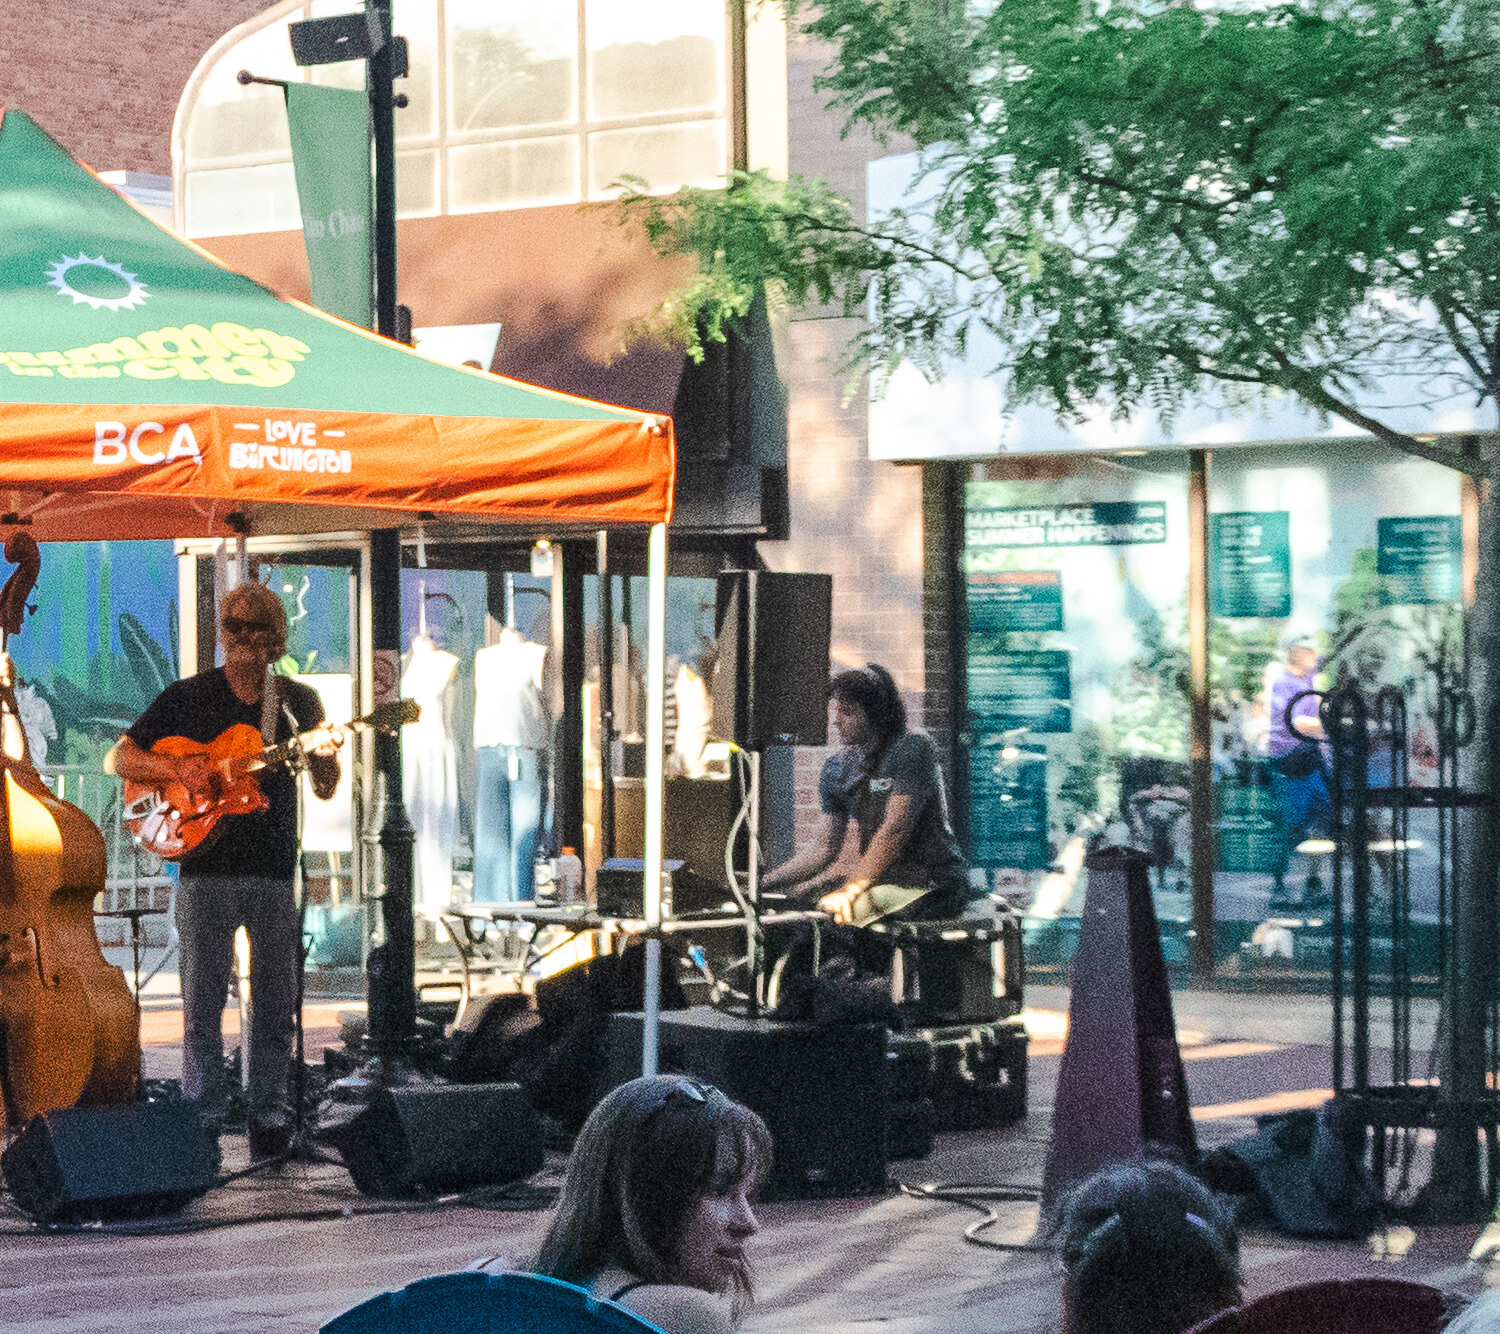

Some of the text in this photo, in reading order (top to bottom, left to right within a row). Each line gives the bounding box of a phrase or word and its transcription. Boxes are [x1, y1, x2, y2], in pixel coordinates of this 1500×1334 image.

[264, 417, 317, 446] LOVE
[92, 420, 352, 473] BCA BURLINGTON
[967, 507, 1095, 528] MARKETPLACE
[966, 526, 1045, 546] SUMMER
